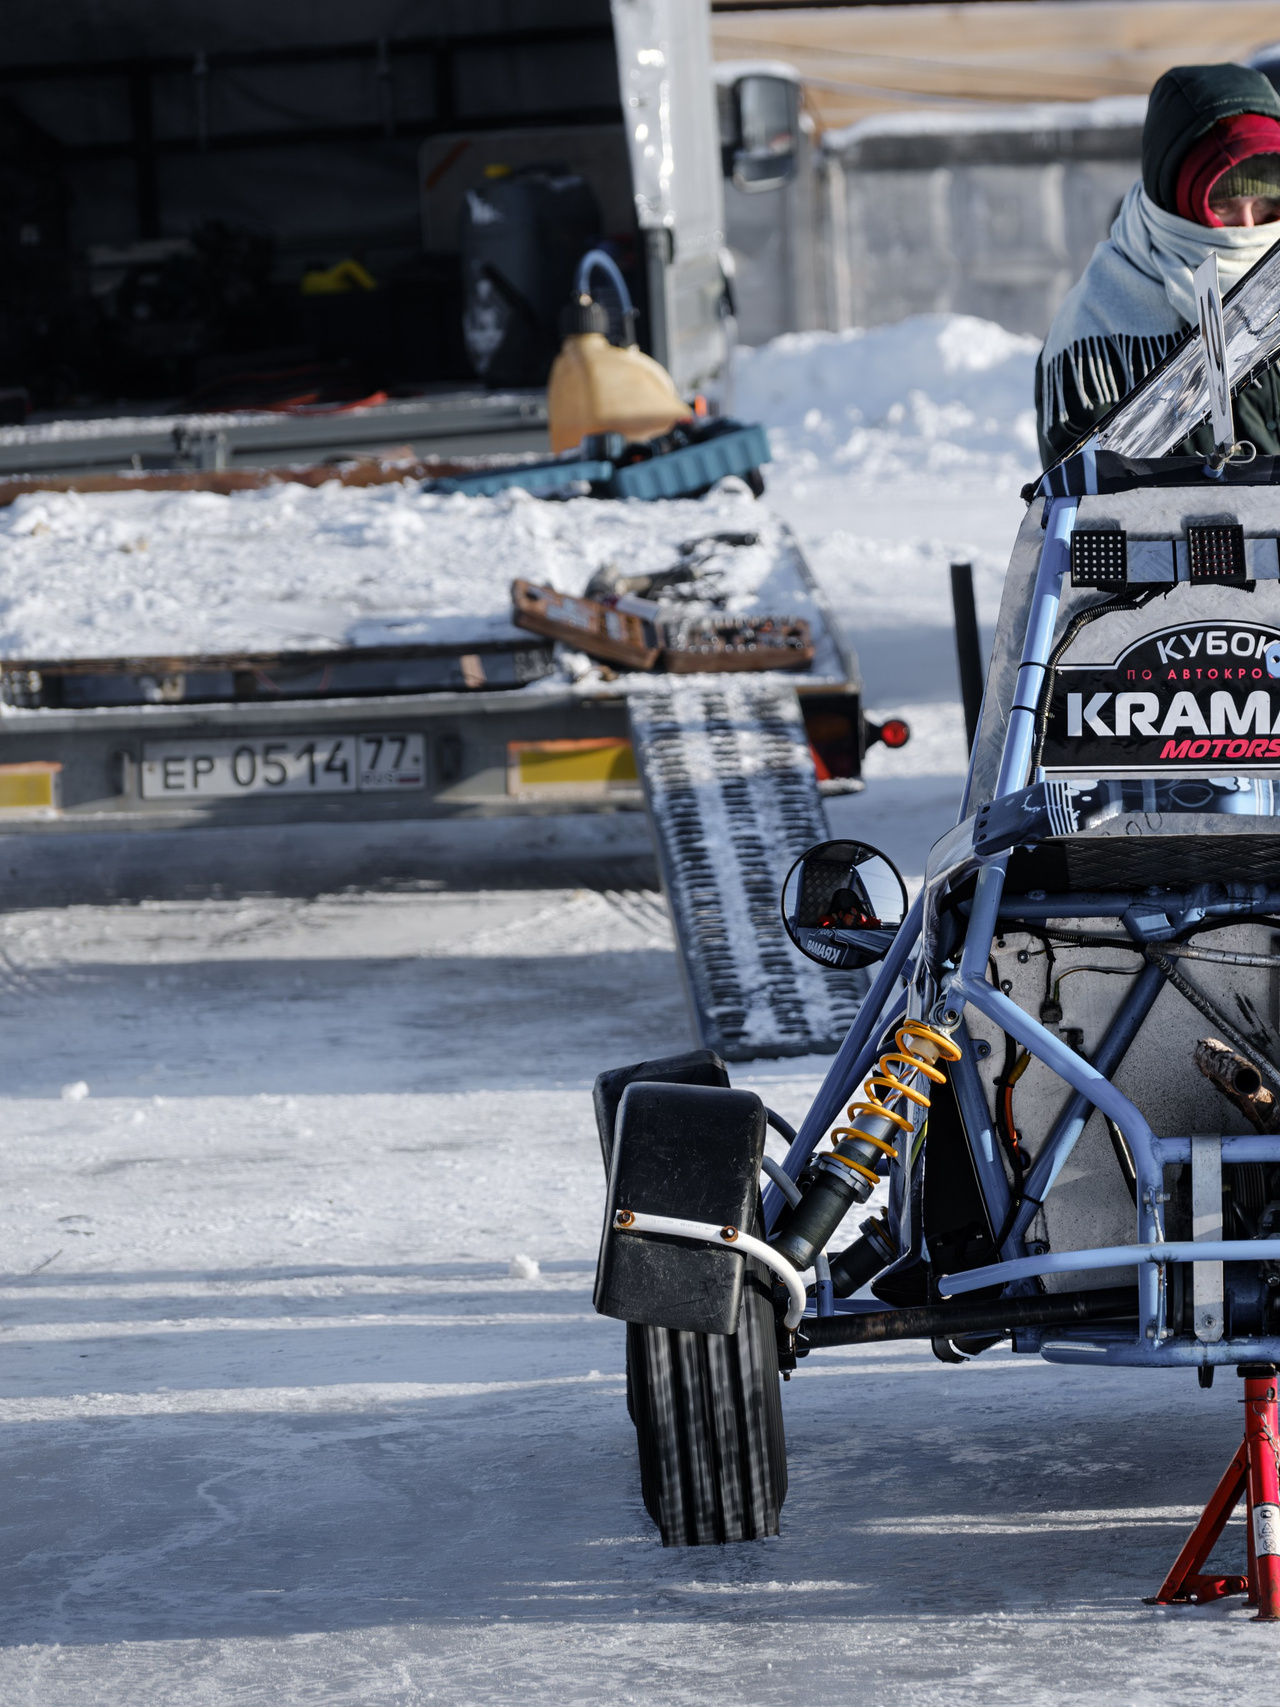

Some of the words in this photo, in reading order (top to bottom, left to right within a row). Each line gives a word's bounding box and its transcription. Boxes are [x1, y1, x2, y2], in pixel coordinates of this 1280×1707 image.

[1127, 669, 1153, 681] ПО
[1168, 667, 1275, 681] АВТОКРО
[232, 738, 349, 787] 0514
[363, 736, 409, 770] 77
